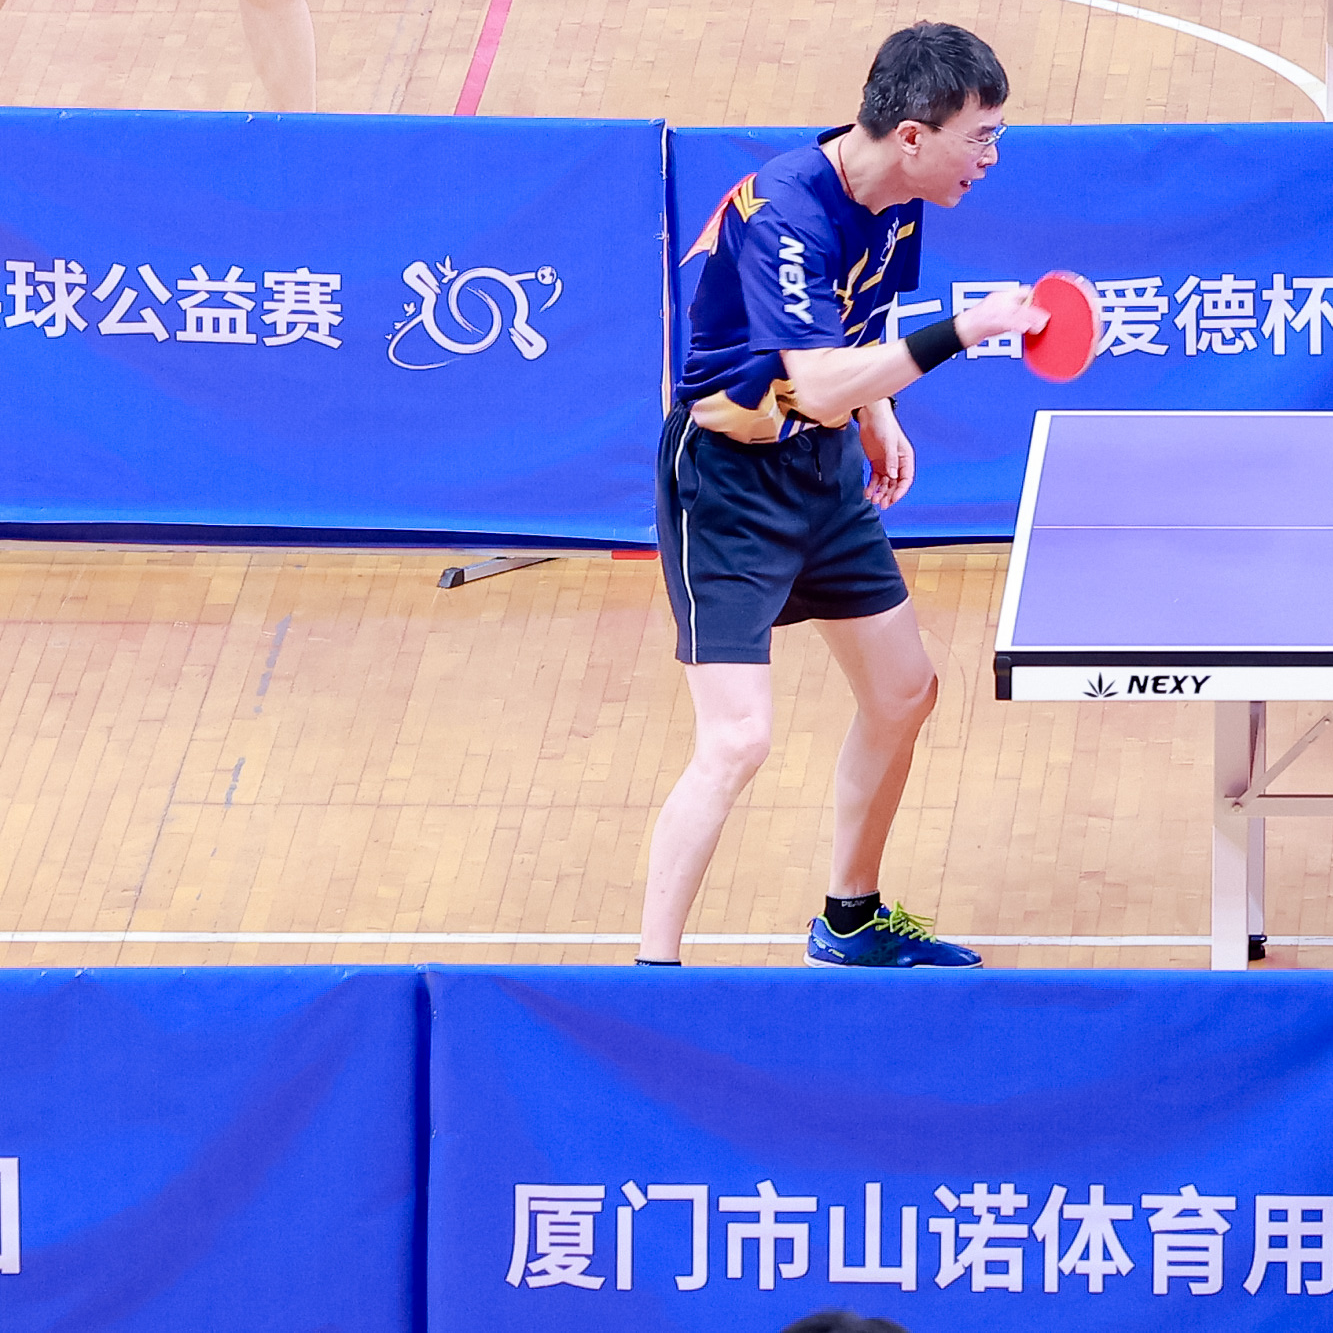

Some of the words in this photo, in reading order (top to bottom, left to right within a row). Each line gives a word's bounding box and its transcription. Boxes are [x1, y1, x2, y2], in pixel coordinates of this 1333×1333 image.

[4, 260, 342, 348] 球公益赛
[779, 235, 814, 324] NEXY
[1126, 675, 1211, 695] NEXY
